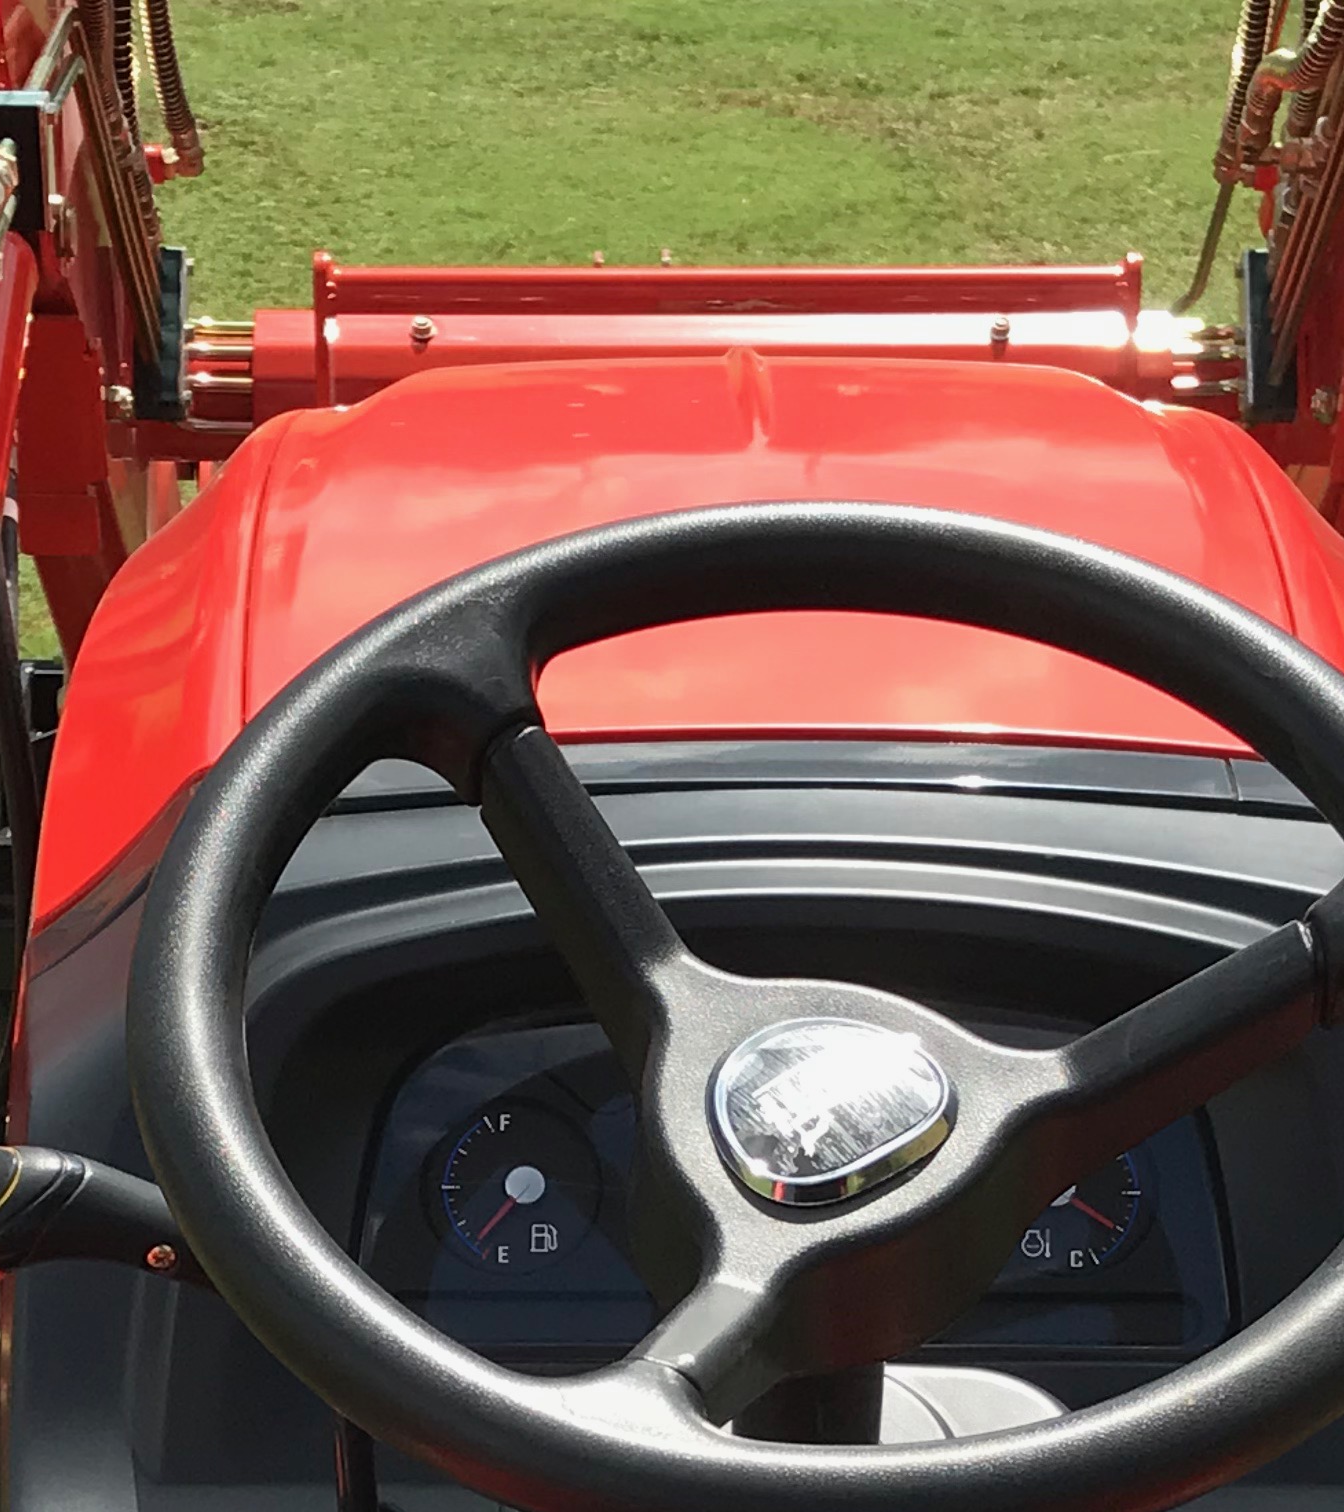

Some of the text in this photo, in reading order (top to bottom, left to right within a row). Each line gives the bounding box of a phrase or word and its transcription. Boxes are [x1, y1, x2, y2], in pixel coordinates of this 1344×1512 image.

[498, 1113, 512, 1132] F
[497, 1245, 510, 1264] E
[1069, 1249, 1084, 1268] C
